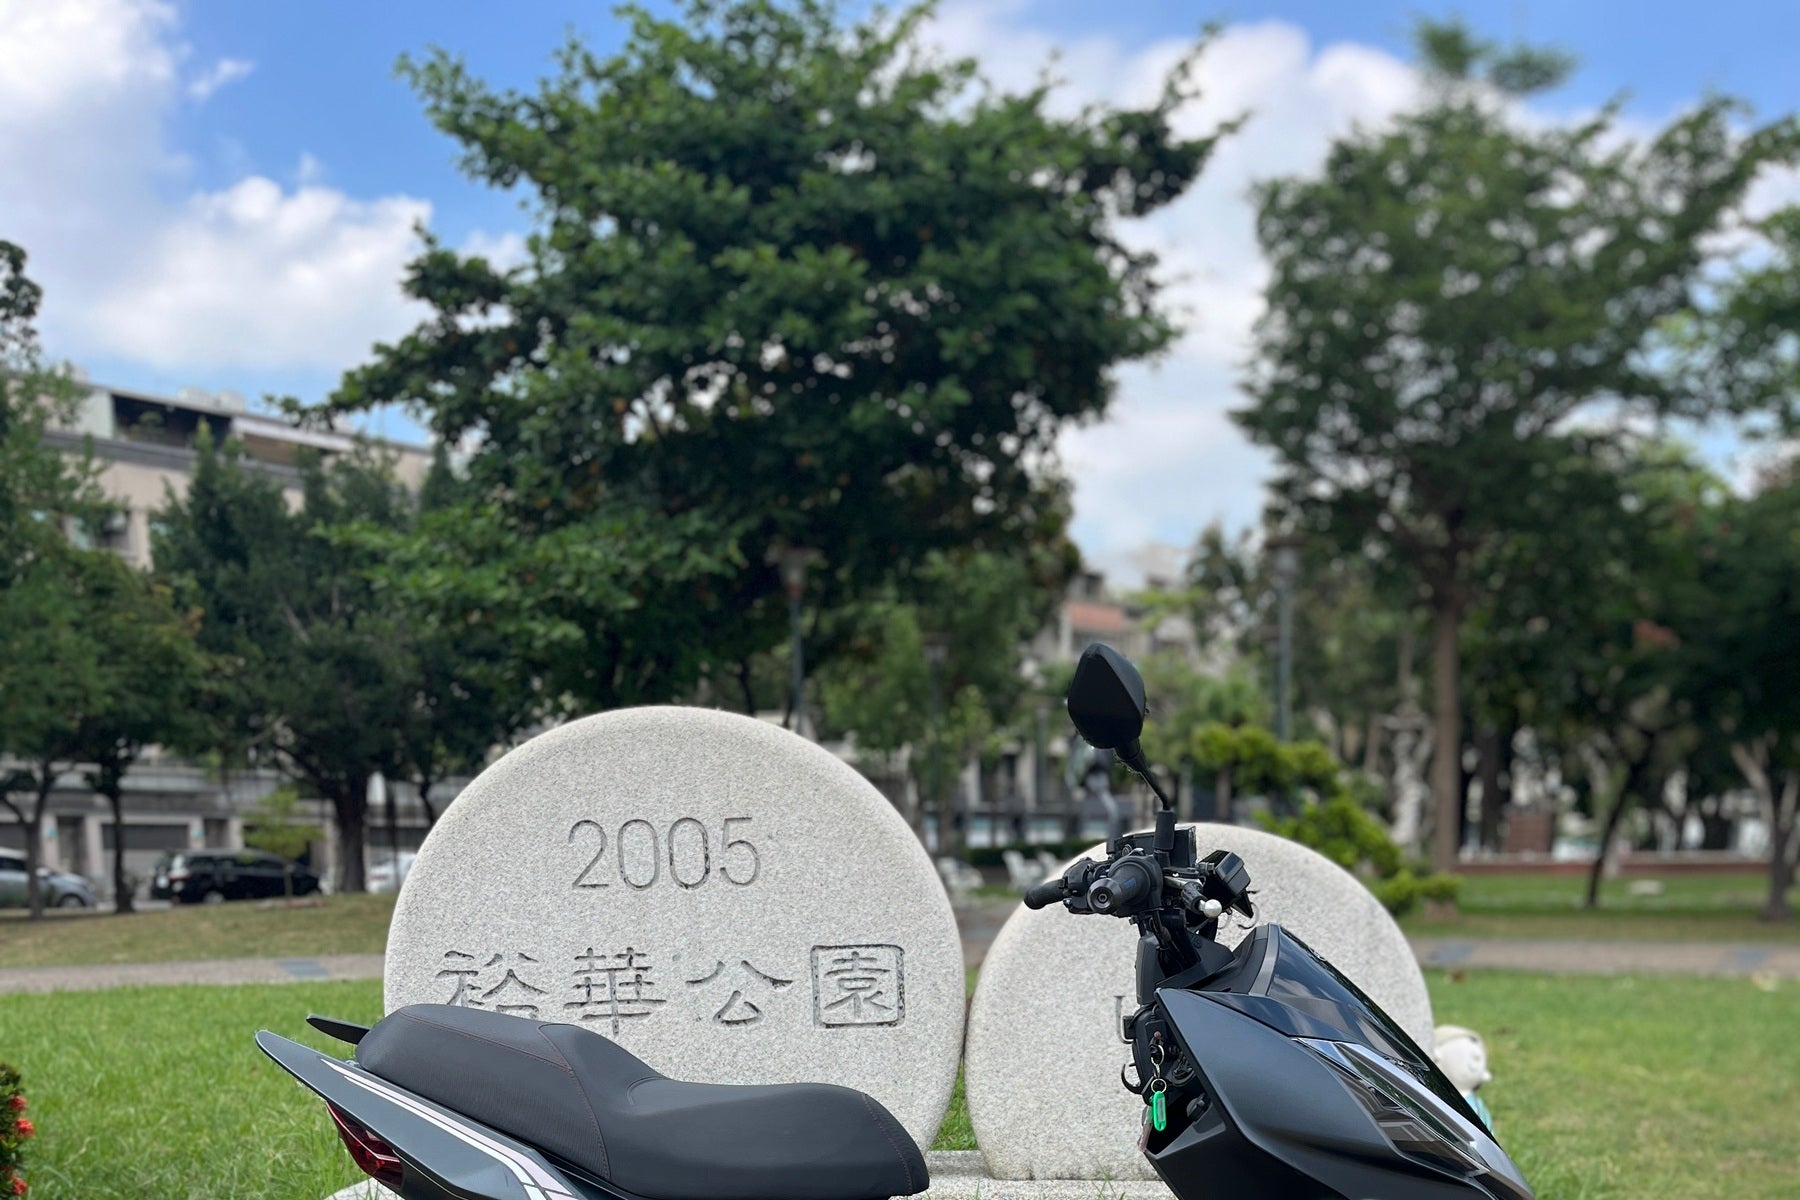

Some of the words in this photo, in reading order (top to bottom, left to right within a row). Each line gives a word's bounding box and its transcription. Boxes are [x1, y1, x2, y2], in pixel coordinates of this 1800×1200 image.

[568, 817, 761, 890] 2005
[436, 944, 905, 1036] 裕華公園
